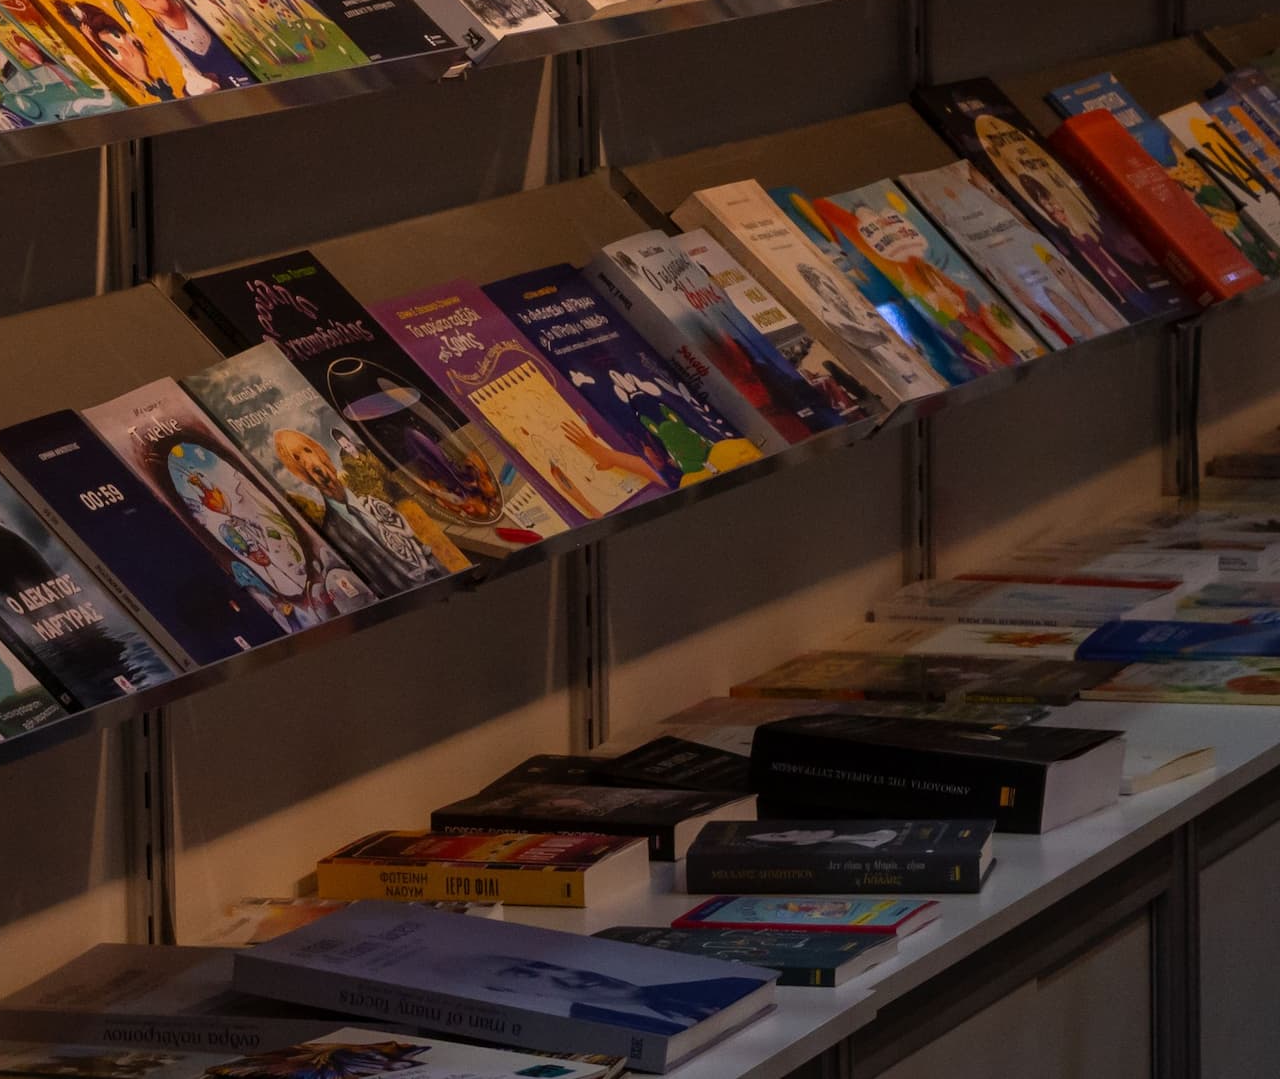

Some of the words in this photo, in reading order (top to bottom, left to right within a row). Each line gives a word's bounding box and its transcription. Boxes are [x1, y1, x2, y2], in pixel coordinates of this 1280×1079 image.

[127, 415, 184, 447] Twelve
[79, 483, 126, 512] 00:59
[19, 574, 82, 613] ΔΕΚΑΤΟΣ
[32, 602, 106, 643] ΜΑΡΤΥΡΑΣ
[397, 999, 442, 1023] many
[469, 1011, 507, 1032] man
